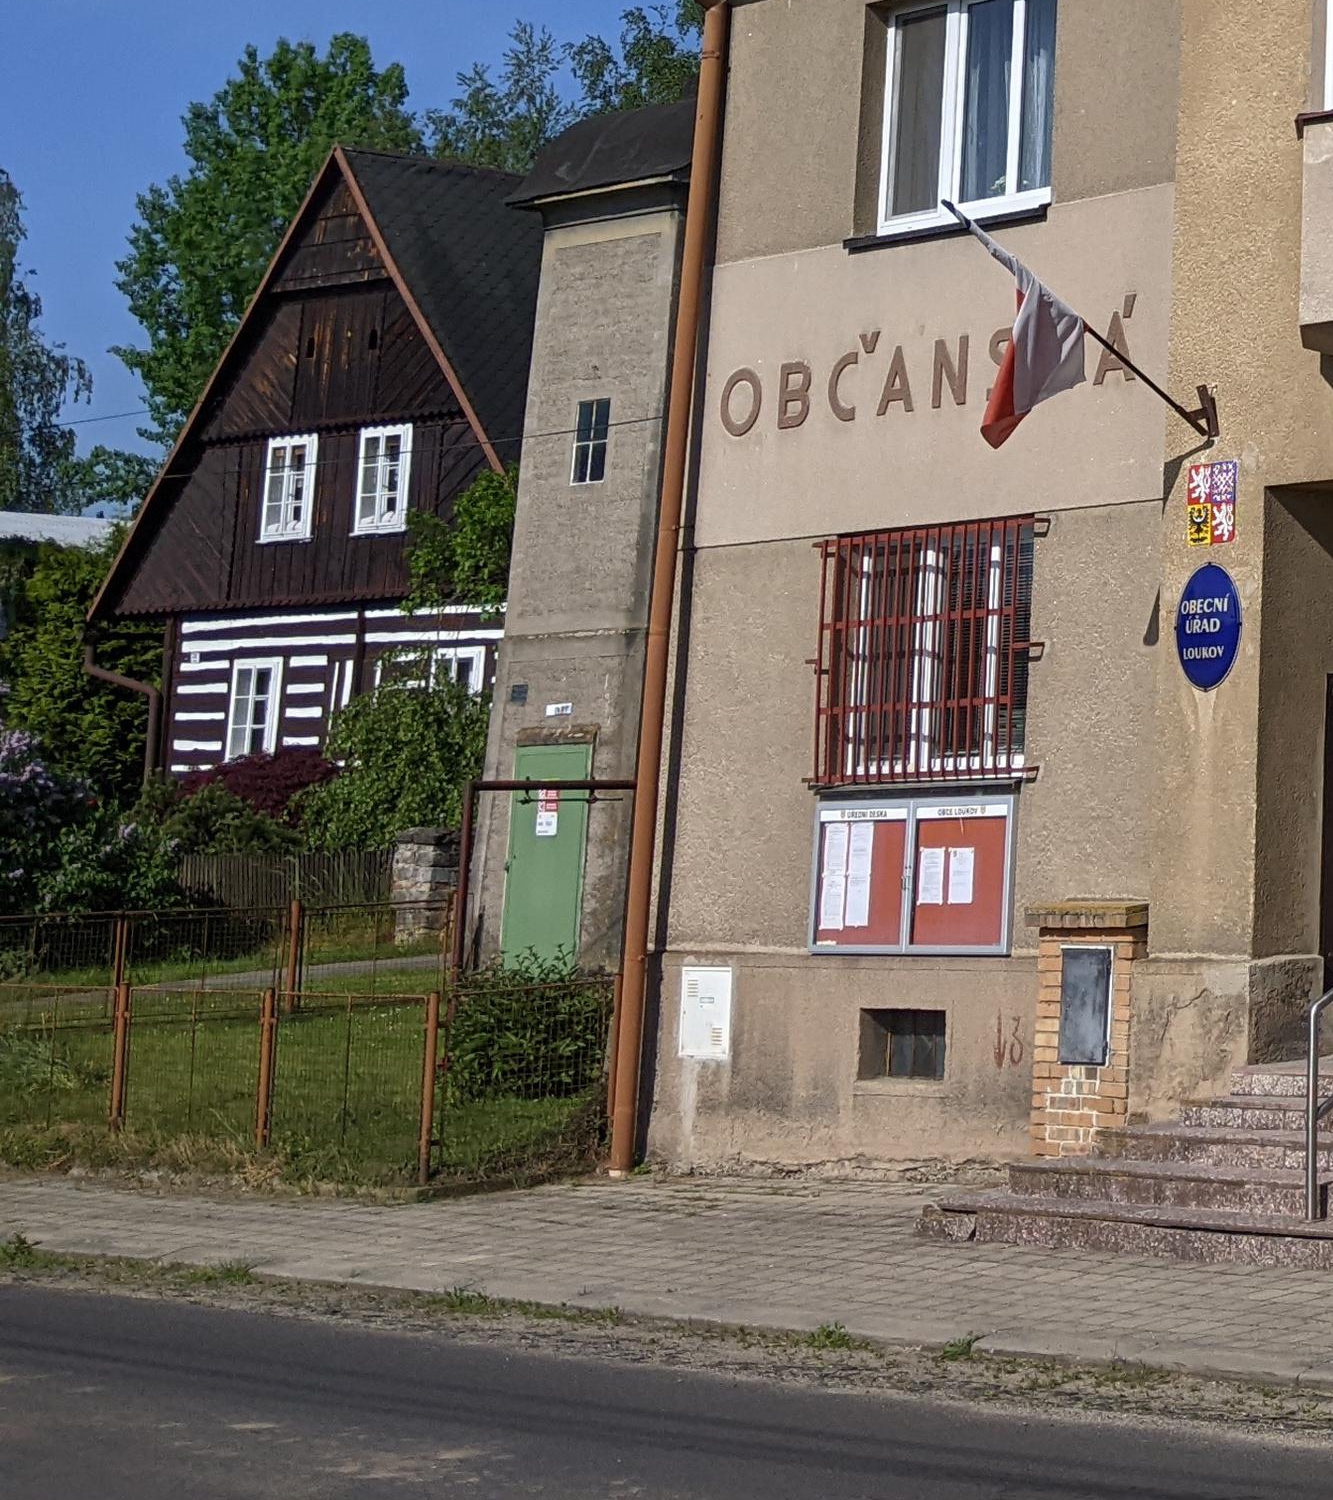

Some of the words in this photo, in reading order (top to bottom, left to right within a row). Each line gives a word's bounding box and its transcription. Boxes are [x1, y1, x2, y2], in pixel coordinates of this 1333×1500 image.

[720, 290, 1138, 437] OBČANÁ
[1181, 593, 1229, 614] OBECNÍ
[1185, 614, 1220, 634] ÚŘAD
[1183, 645, 1225, 660] LOUKOV
